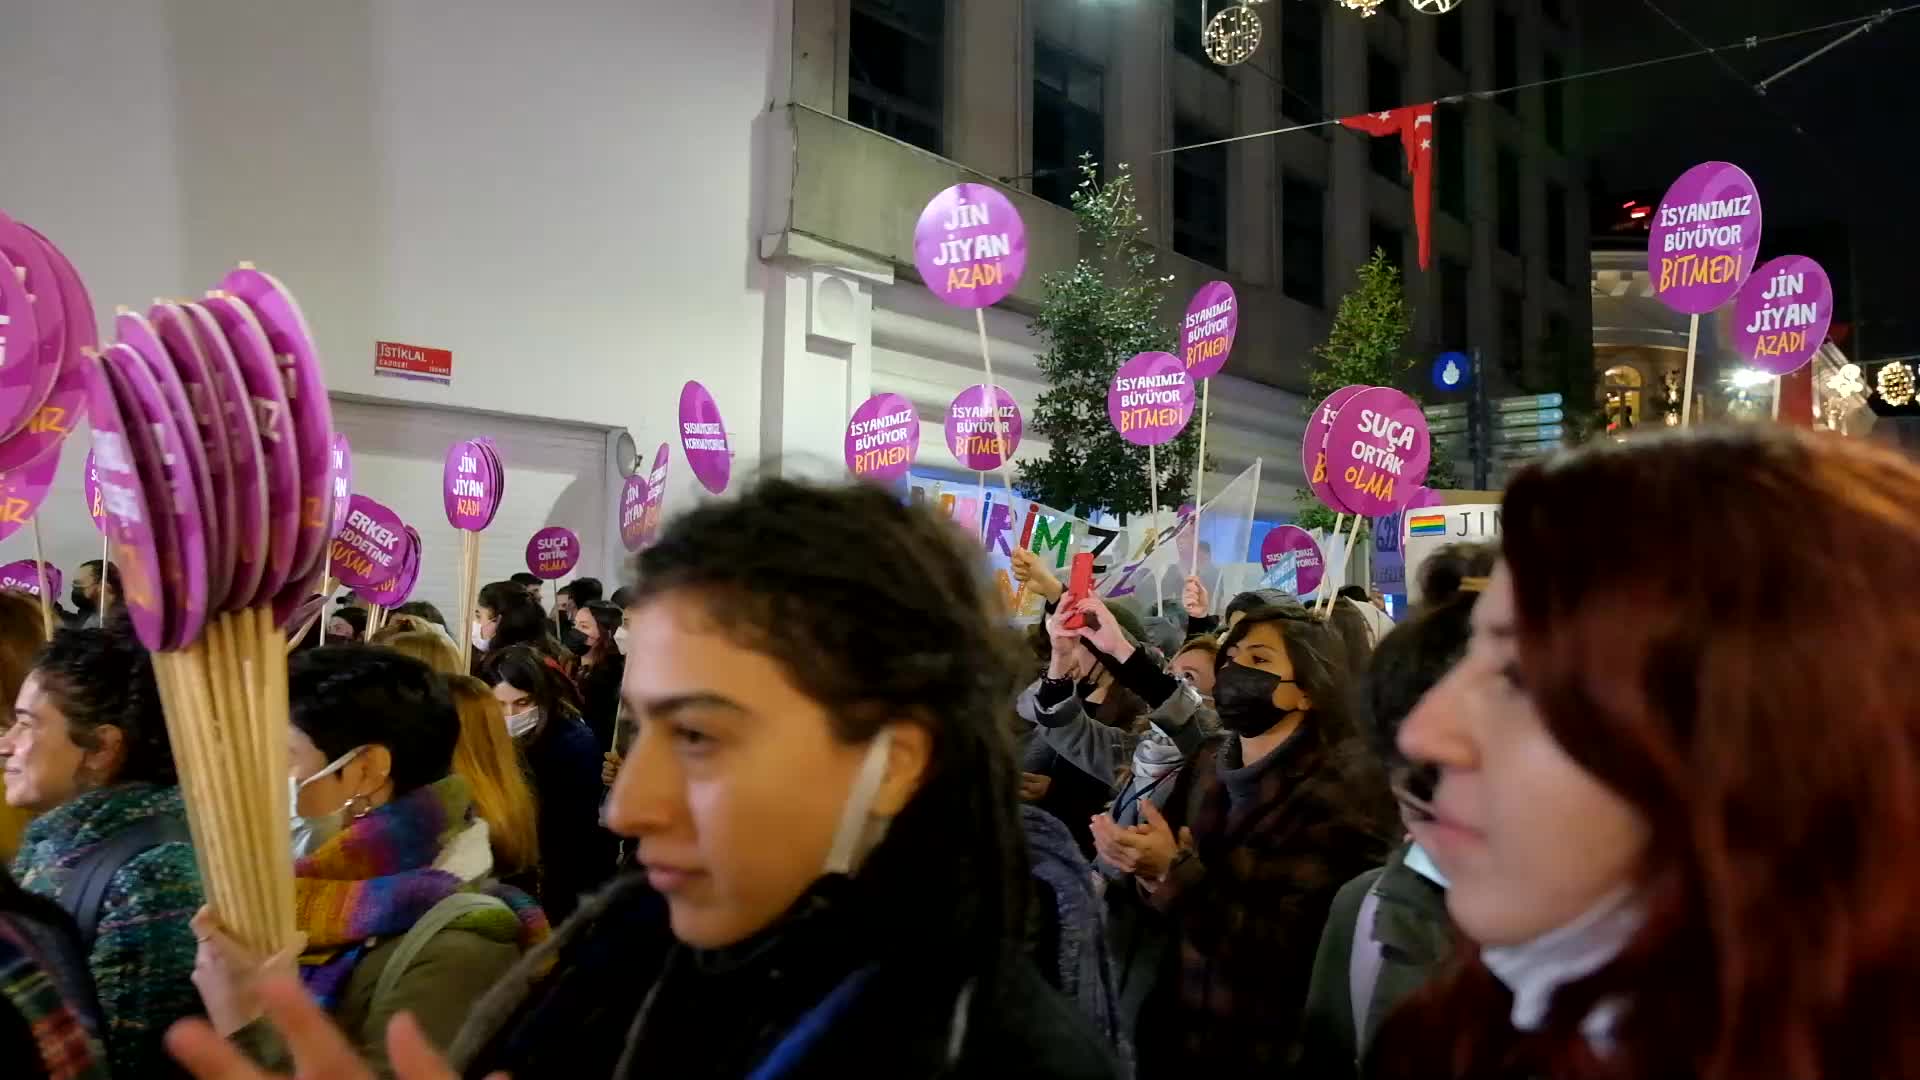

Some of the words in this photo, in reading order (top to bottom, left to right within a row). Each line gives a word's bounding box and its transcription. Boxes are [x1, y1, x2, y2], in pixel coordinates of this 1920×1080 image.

[944, 198, 990, 230] JİN
[1660, 195, 1753, 227] İSYANIMIZ
[933, 233, 1010, 265] JİYAN
[1664, 225, 1741, 252] BÜYÜYOR
[947, 258, 1003, 293] AZADİ
[1660, 247, 1743, 293] BİTMEDİ
[1762, 269, 1803, 300] JİN
[1186, 297, 1232, 328] İSYANIMIZ
[1746, 302, 1817, 334] JİYAN
[1188, 317, 1228, 343] BÜYÜYOR
[1755, 326, 1807, 359] AZADİ
[1186, 334, 1229, 369] BİTMEDİ
[1116, 372, 1185, 391] İSYANIMIZ
[1121, 389, 1180, 407] BÜYÜYOR
[851, 409, 912, 437] İSYANIMIZ
[1120, 404, 1183, 432] BİTMEDİ
[1358, 409, 1414, 452] SUÇA
[856, 427, 907, 452] BÜYÜYOR
[458, 452, 477, 473] JİN
[855, 446, 911, 475] BİTMEDİ
[1351, 441, 1404, 475] ORTAK
[453, 475, 484, 498] JİYAN
[1345, 465, 1394, 502] OLMA
[347, 510, 399, 550] ERKEK
[338, 528, 393, 567] İDDETİNE
